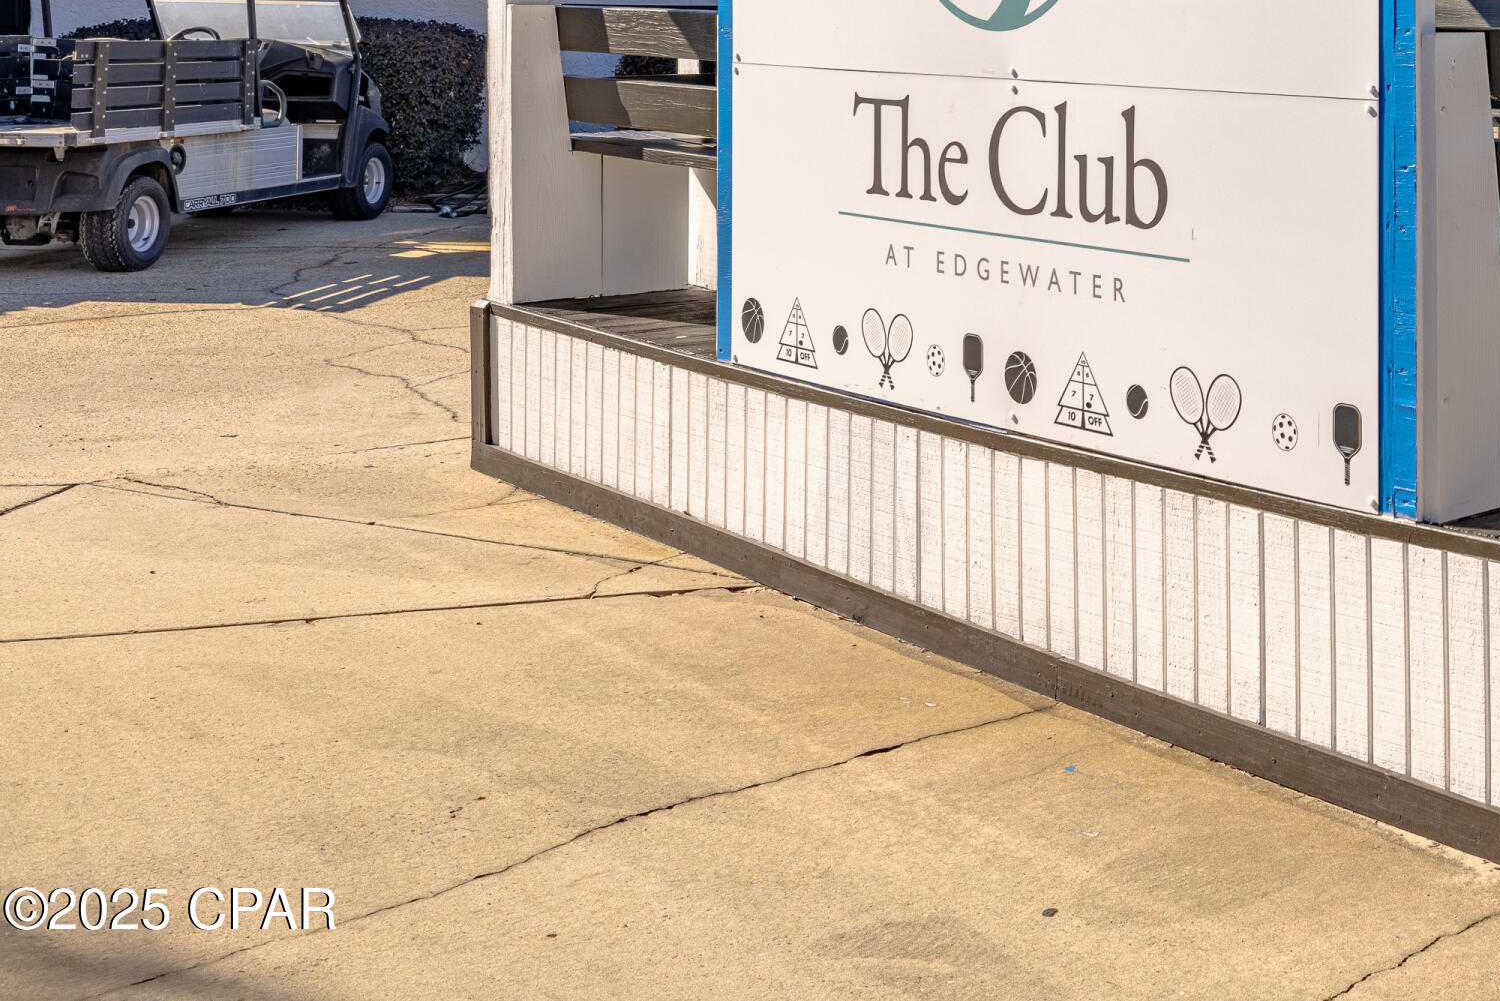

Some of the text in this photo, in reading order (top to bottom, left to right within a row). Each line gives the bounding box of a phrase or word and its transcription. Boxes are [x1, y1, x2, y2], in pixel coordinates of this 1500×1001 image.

[853, 91, 1169, 230] The Club
[885, 243, 1126, 303] AT EDGEWATER
[800, 352, 811, 361] OFF
[1068, 410, 1102, 427] 10 OFF
